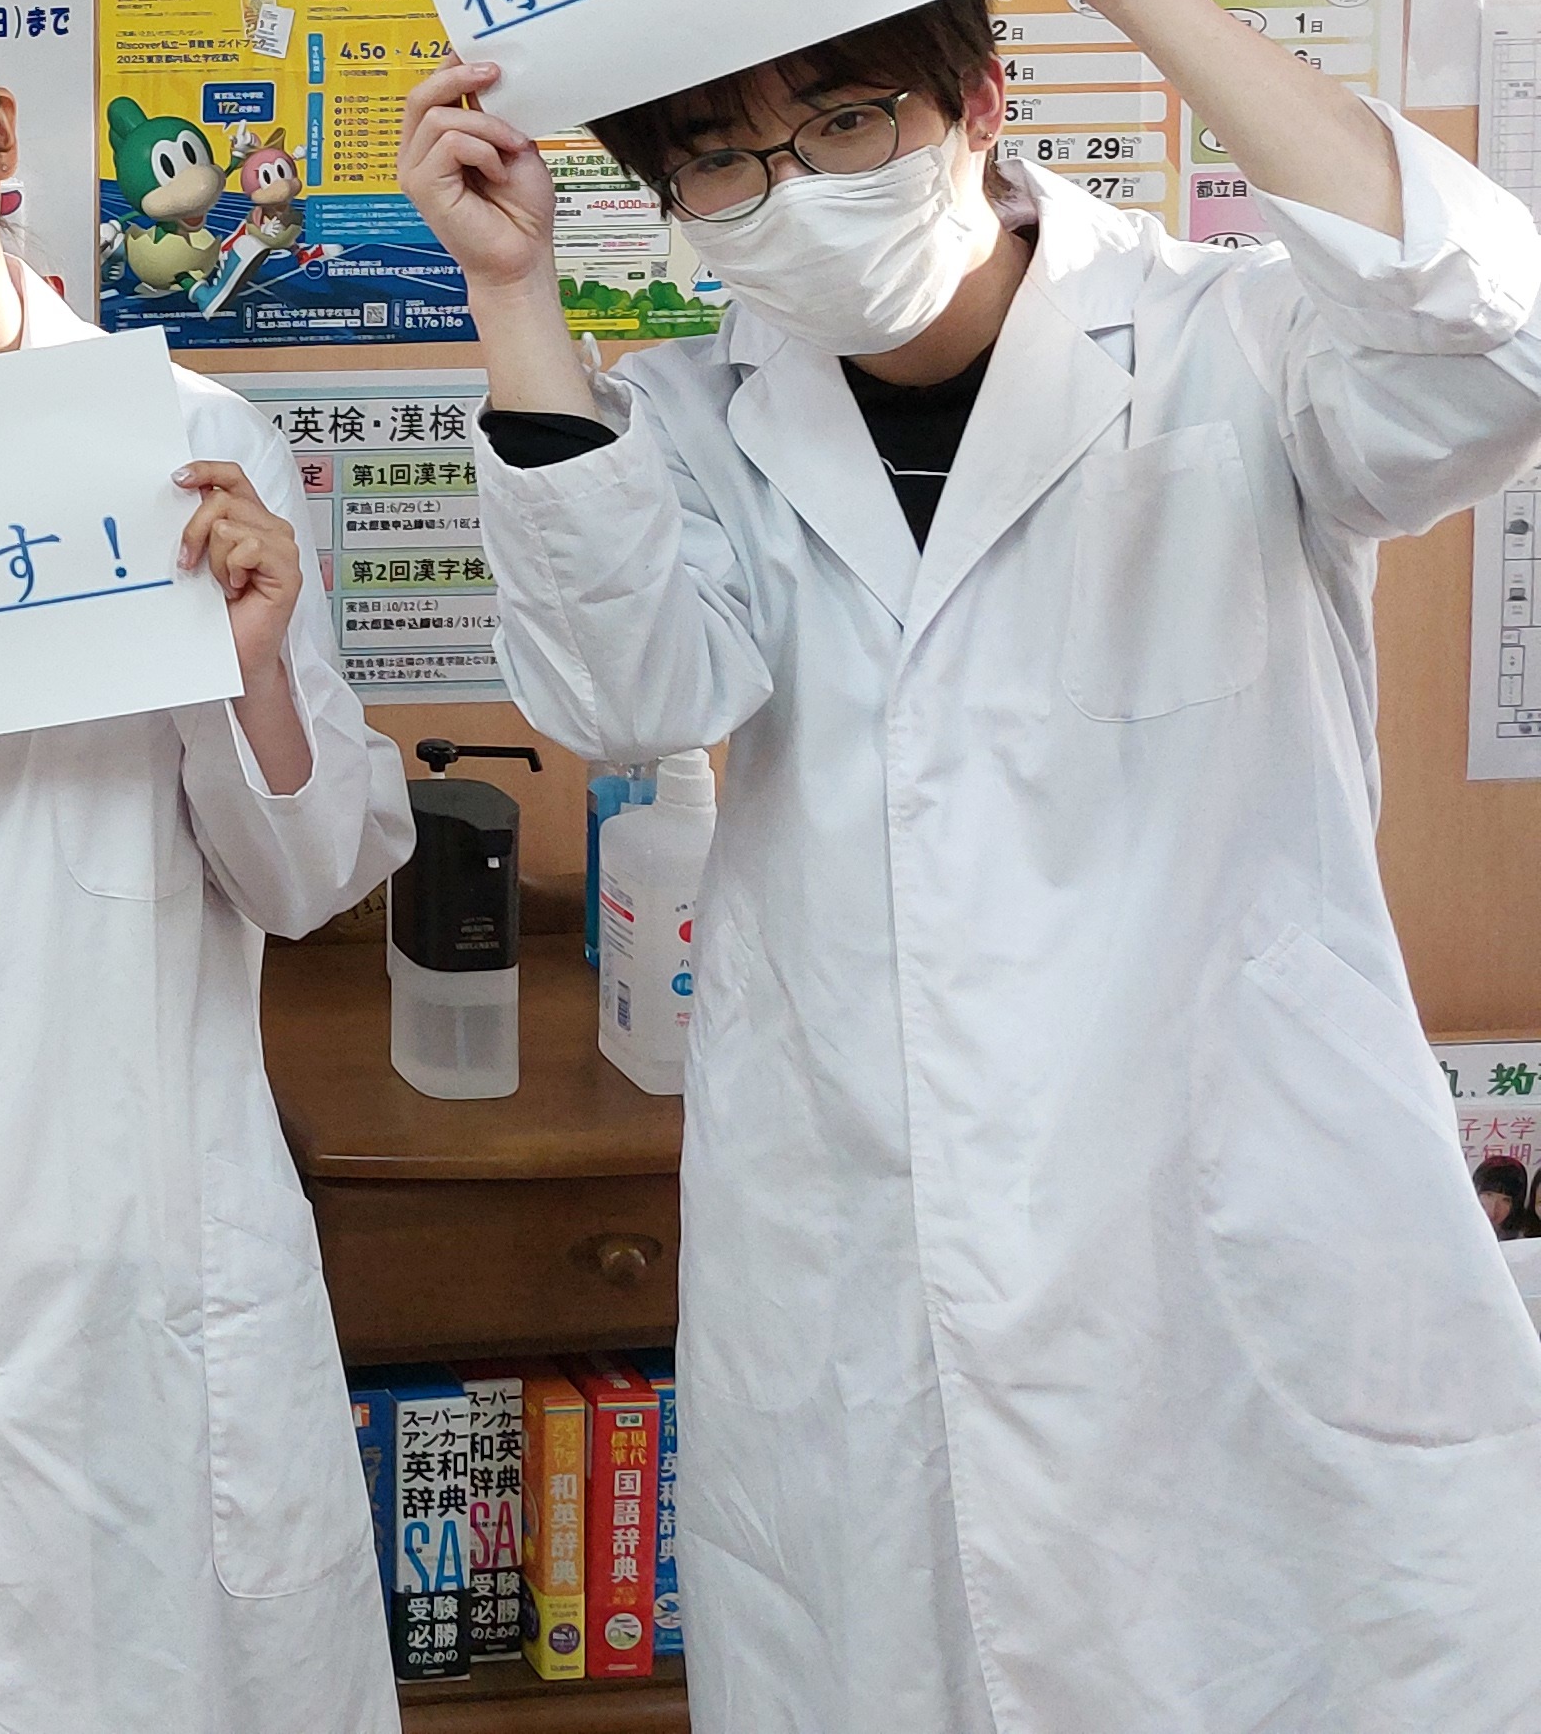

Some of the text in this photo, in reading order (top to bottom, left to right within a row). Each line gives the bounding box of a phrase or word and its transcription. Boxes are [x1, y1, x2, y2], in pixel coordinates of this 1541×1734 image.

[1086, 137, 1134, 160] 29日
[1086, 177, 1134, 200] 27日
[1196, 179, 1248, 199] 都立自
[352, 557, 494, 584] 第2回漢字検
[402, 1407, 469, 1428] スーパー
[401, 1428, 469, 1449] アンカー
[469, 1429, 522, 1463] 和英
[402, 1449, 468, 1484] 英和
[469, 1464, 521, 1499] 辞典
[401, 1483, 468, 1519] 辞典
[469, 1500, 517, 1569] SA
[549, 1472, 579, 1584] 和英辞典
[611, 1469, 642, 1584] 国語辞典
[403, 1520, 465, 1593] SA
[471, 1571, 520, 1598] 受験
[407, 1595, 459, 1623] 受験
[470, 1598, 521, 1624] 必勝
[407, 1623, 459, 1649] 必勝
[470, 1625, 521, 1640] のための
[407, 1649, 459, 1665] のための
